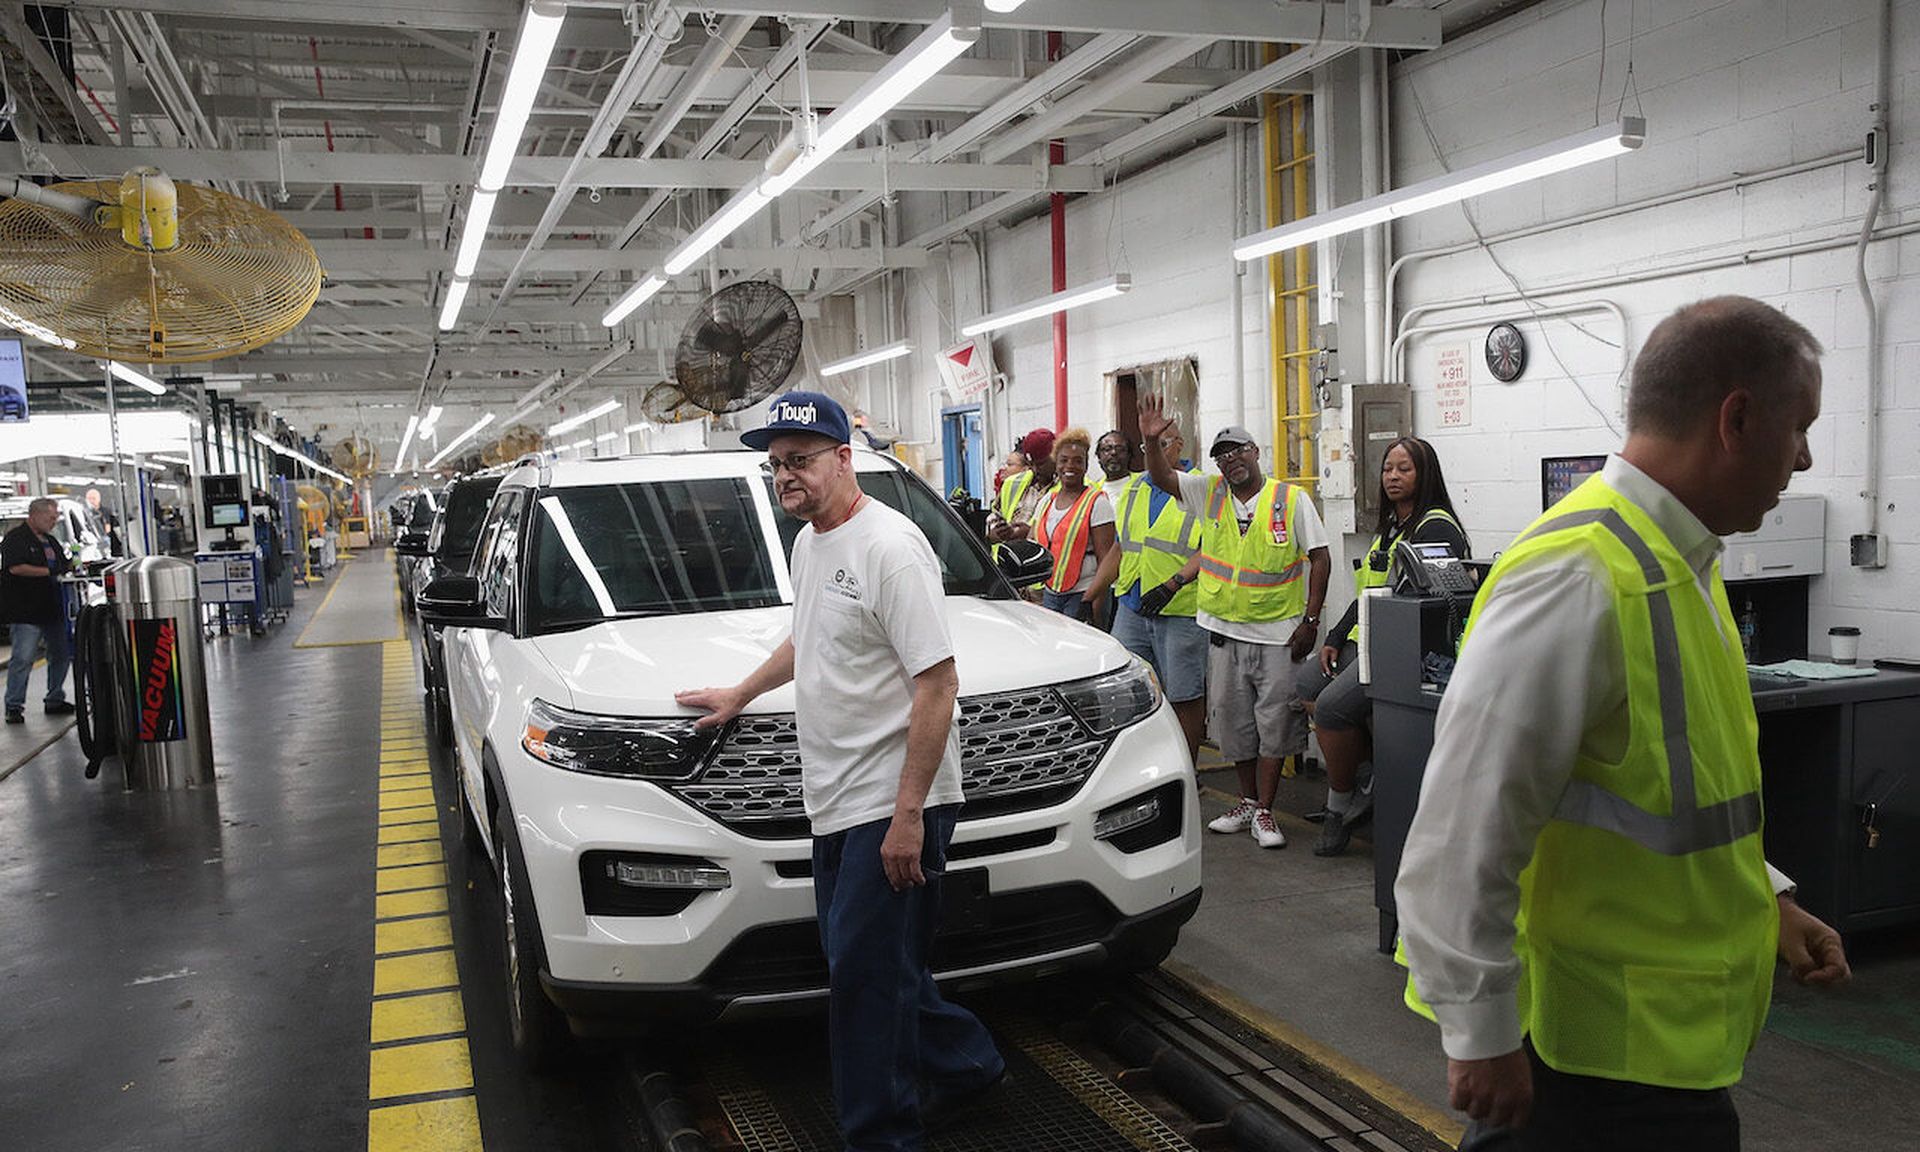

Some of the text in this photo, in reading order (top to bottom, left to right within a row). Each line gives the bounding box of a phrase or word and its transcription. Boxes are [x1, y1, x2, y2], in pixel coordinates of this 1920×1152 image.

[961, 370, 982, 381] FIRE
[965, 380, 989, 396] ALARM
[780, 402, 817, 425] Tough
[138, 623, 176, 740] VACUUM
